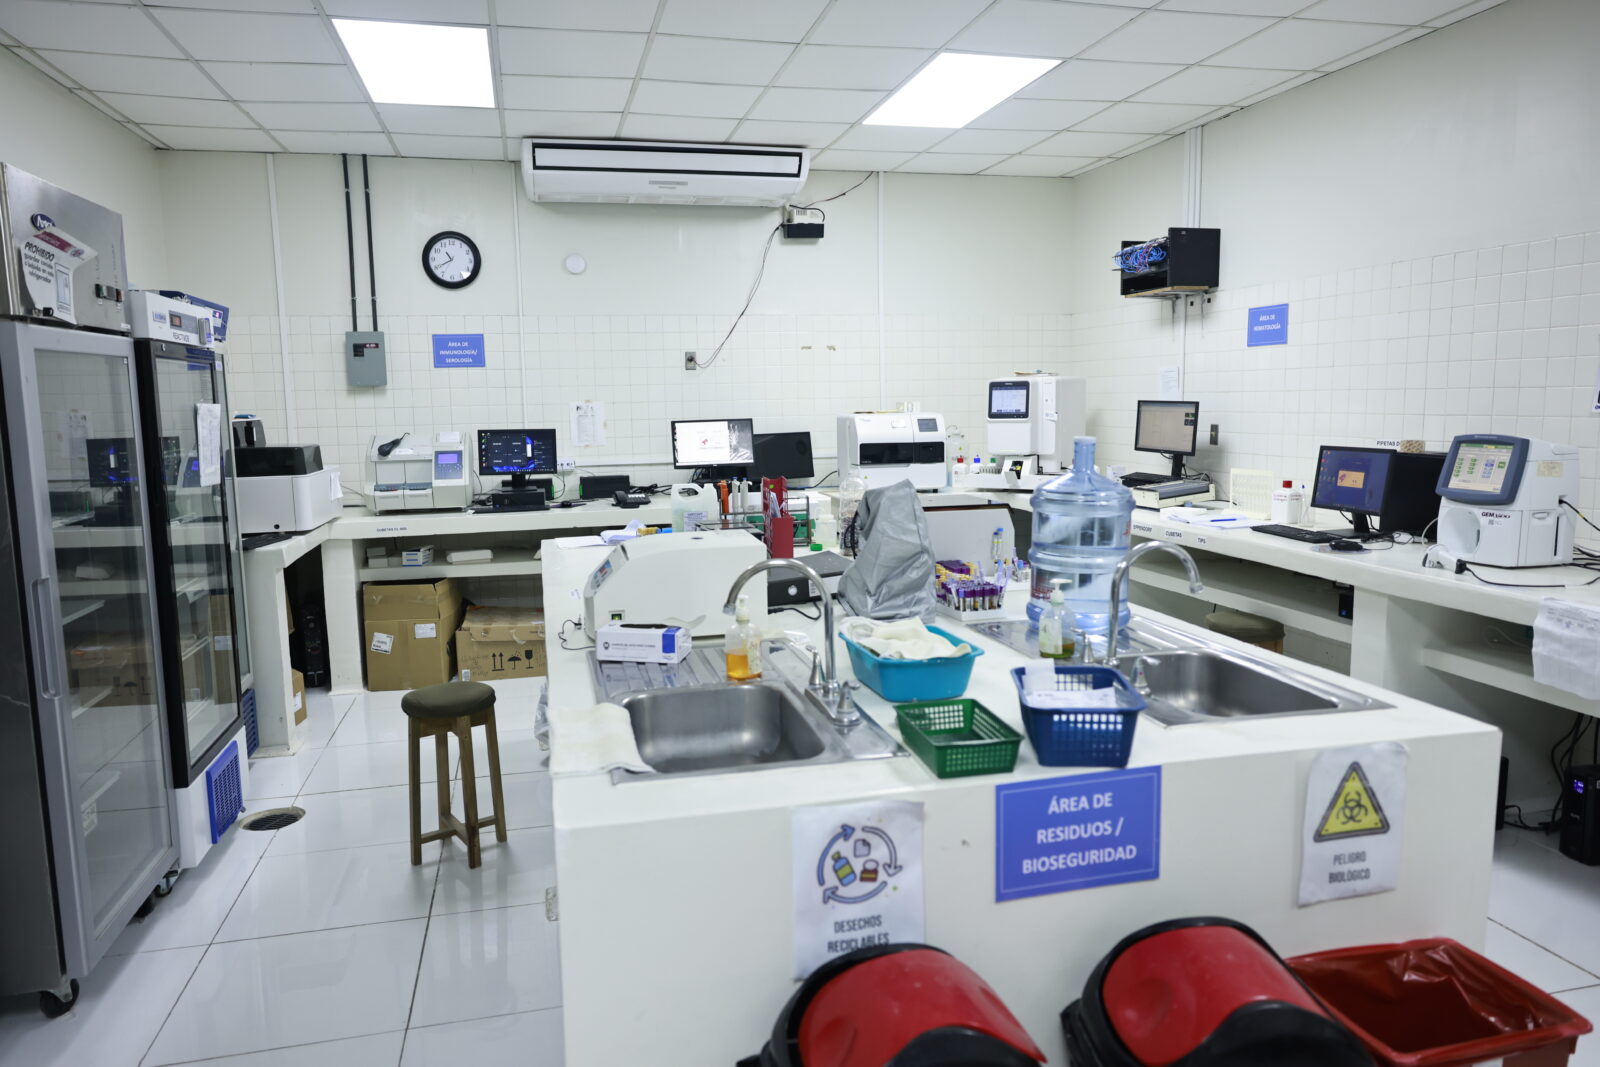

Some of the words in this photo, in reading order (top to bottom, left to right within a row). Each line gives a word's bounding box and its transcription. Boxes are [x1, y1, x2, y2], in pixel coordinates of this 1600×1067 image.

[25, 241, 55, 262] PROHIBIDO
[1047, 794, 1090, 815] ÁREA
[1092, 791, 1114, 809] DE
[1036, 819, 1113, 845] RESIDUOS
[1022, 844, 1138, 875] BIOSEGURIDAD
[1332, 850, 1367, 866] PELIGRO
[833, 914, 883, 934] DESECHOS
[827, 932, 890, 953] RECICLABLES
